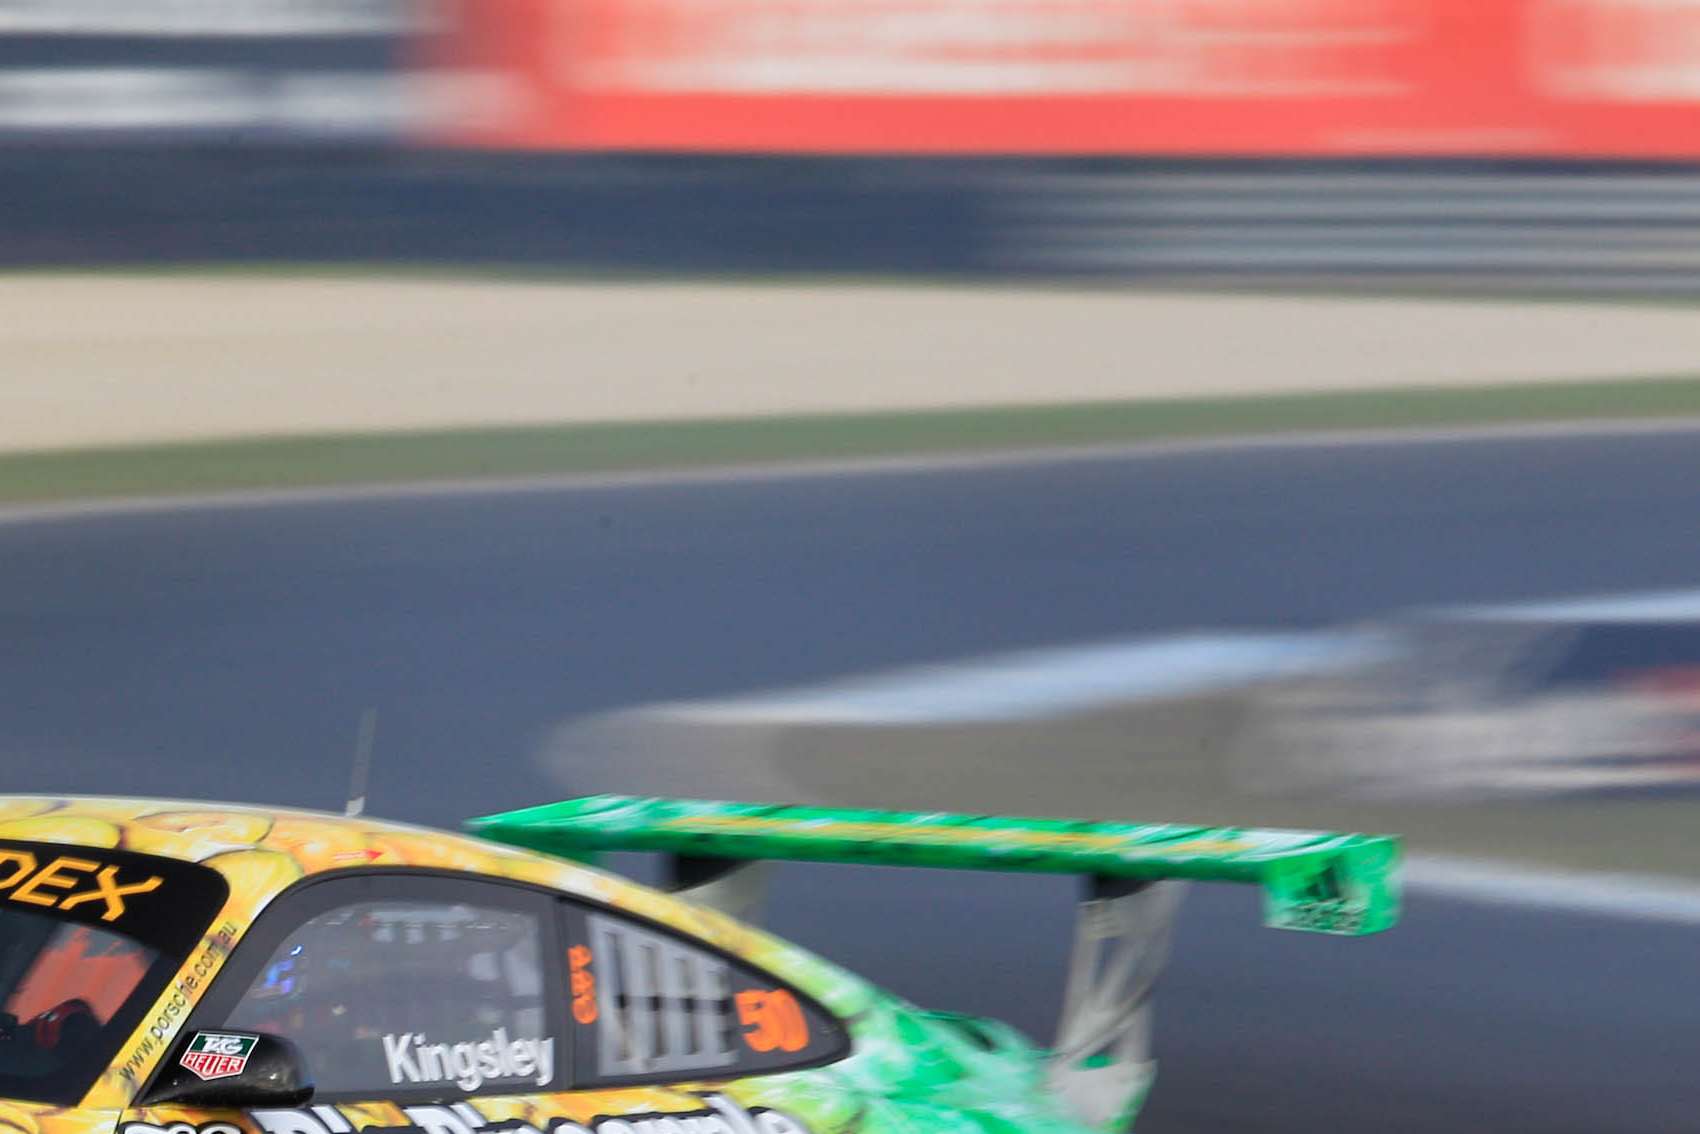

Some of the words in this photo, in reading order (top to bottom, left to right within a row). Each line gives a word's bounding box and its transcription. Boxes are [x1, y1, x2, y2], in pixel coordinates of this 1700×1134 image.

[202, 1036, 244, 1055] TAG
[183, 1053, 242, 1076] HEUER
[383, 1027, 553, 1091] Kingsley
